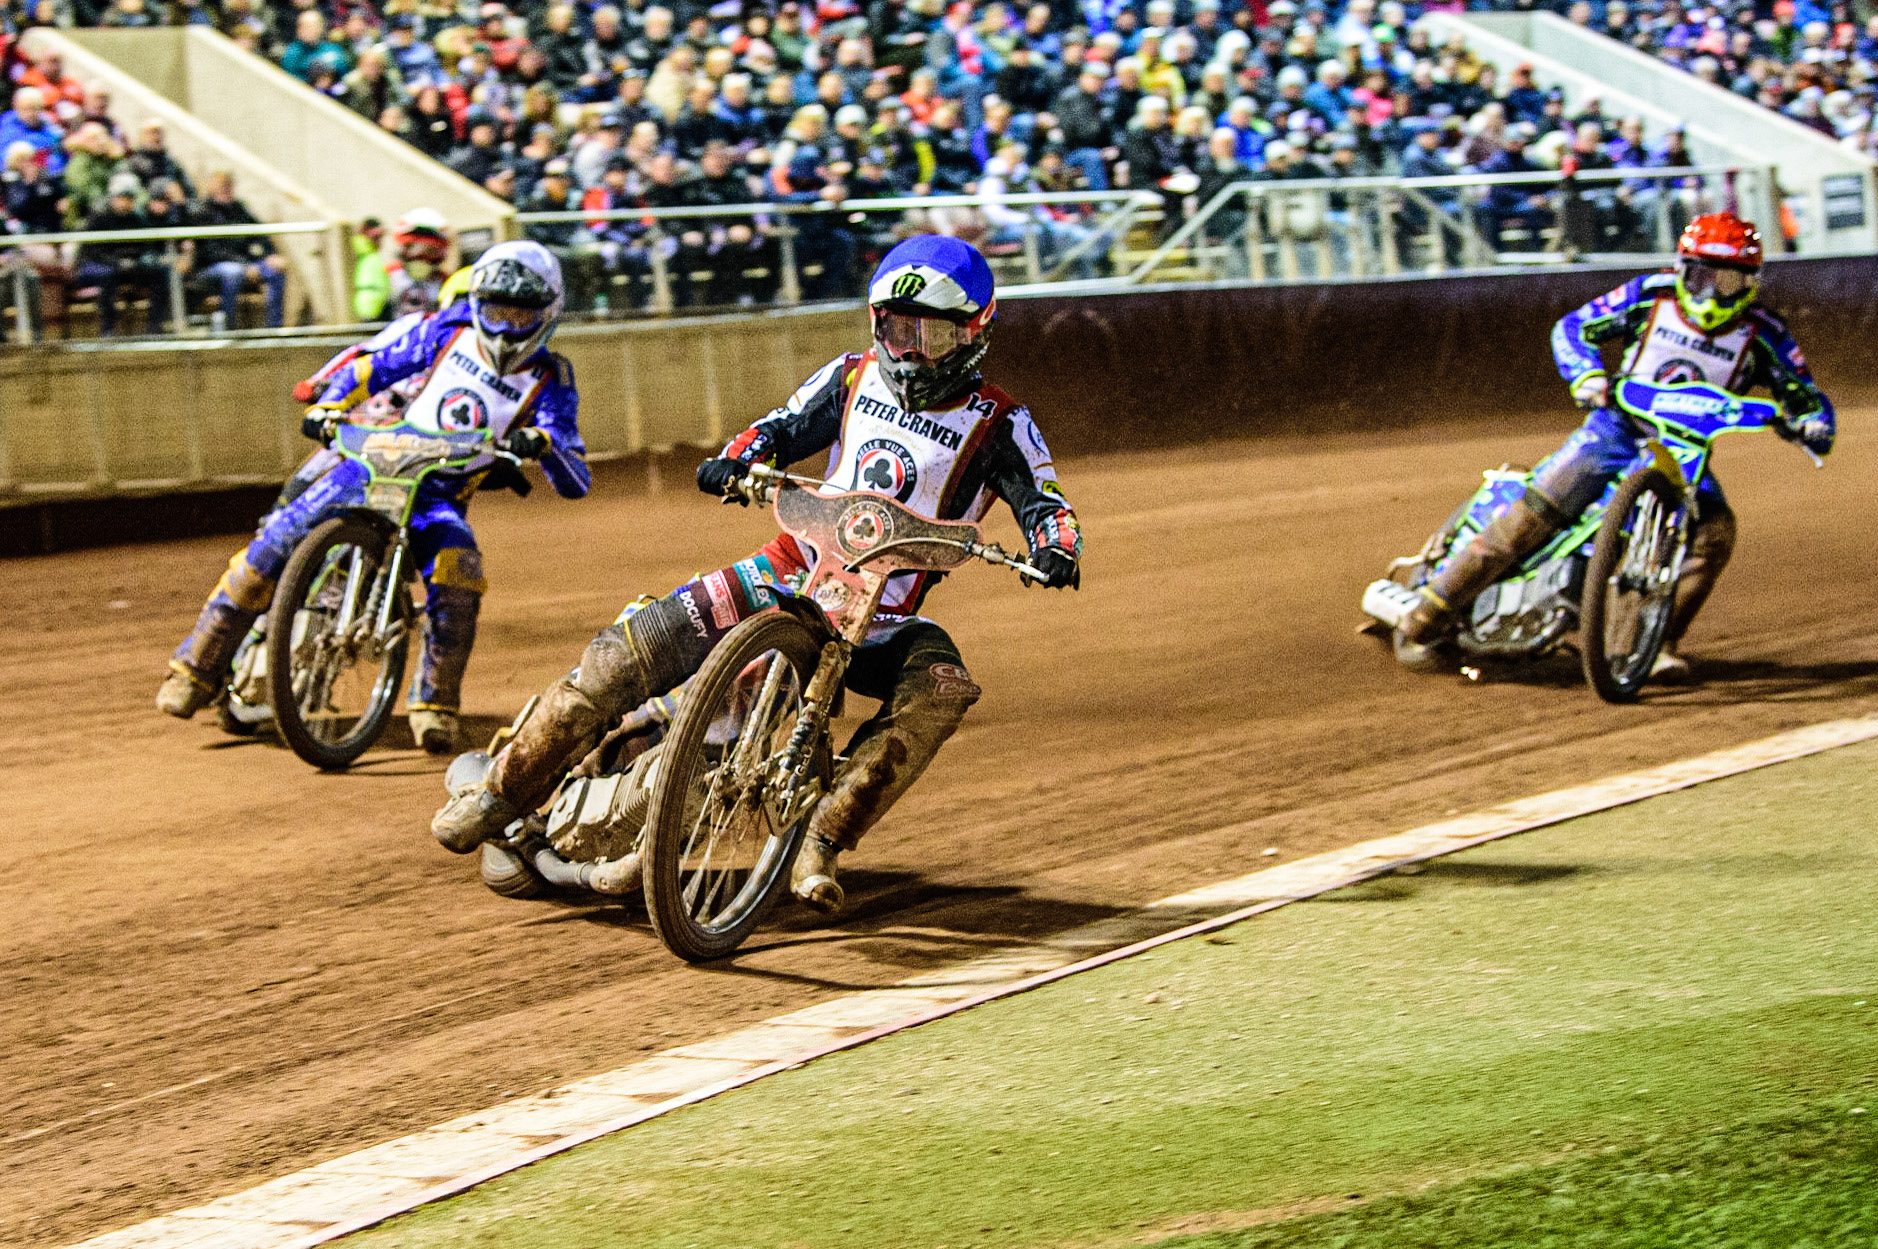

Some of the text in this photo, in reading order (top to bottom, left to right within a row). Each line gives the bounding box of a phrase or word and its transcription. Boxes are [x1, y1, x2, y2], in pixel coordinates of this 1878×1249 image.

[854, 394, 899, 423] PETER
[898, 411, 963, 451] CRAVEN
[966, 392, 997, 419] 14
[885, 441, 905, 456] VUE
[902, 456, 915, 482] ACES
